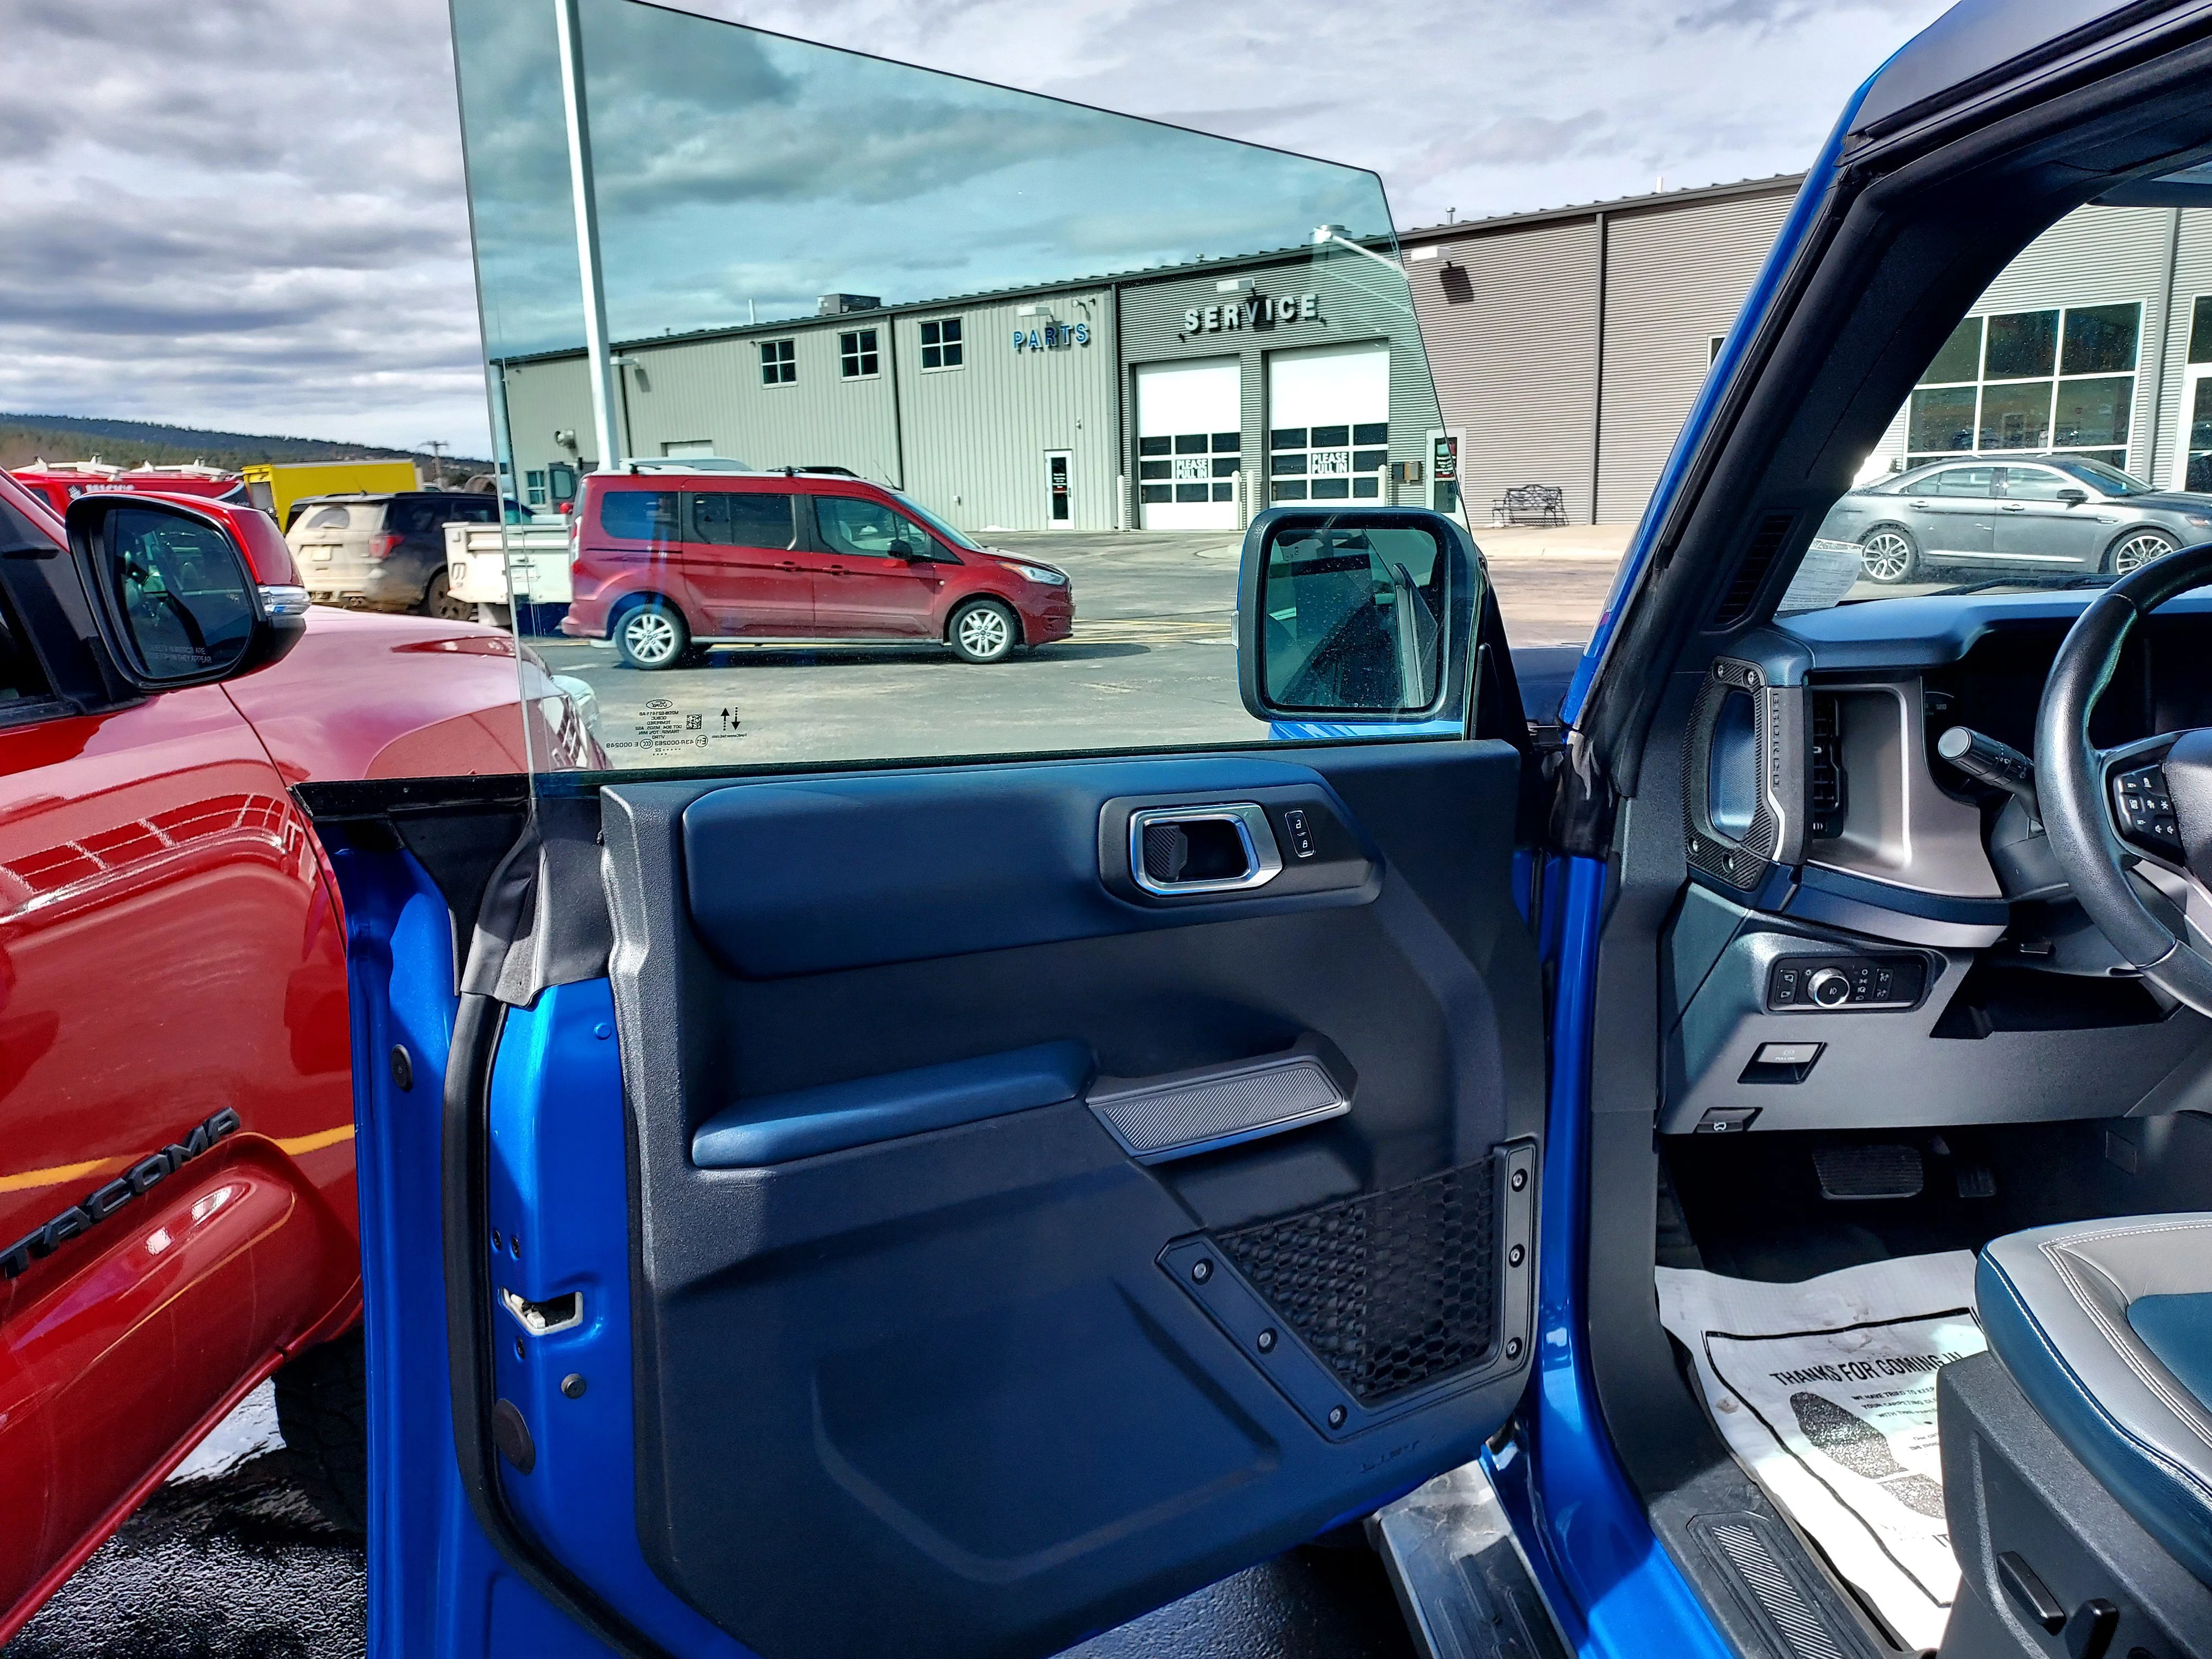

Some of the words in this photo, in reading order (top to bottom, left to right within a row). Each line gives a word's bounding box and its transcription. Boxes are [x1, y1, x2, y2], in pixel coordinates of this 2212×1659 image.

[1184, 294, 1317, 332] SERVICE
[1013, 323, 1088, 349] PARTS
[1176, 459, 1207, 469] PLEASE
[1312, 452, 1348, 464] PLEASE
[1176, 469, 1196, 479] PULL
[1197, 469, 1208, 478] IN
[1312, 463, 1334, 474] PULL
[1335, 463, 1348, 473] IN
[0, 1107, 241, 1279] TACOMA
[1769, 1365, 1843, 1386] THANKS
[1838, 1361, 1881, 1382] FOR
[1877, 1354, 1945, 1376] COMING
[1943, 1351, 1963, 1364] IN
[1882, 1390, 1906, 1398] TRIED
